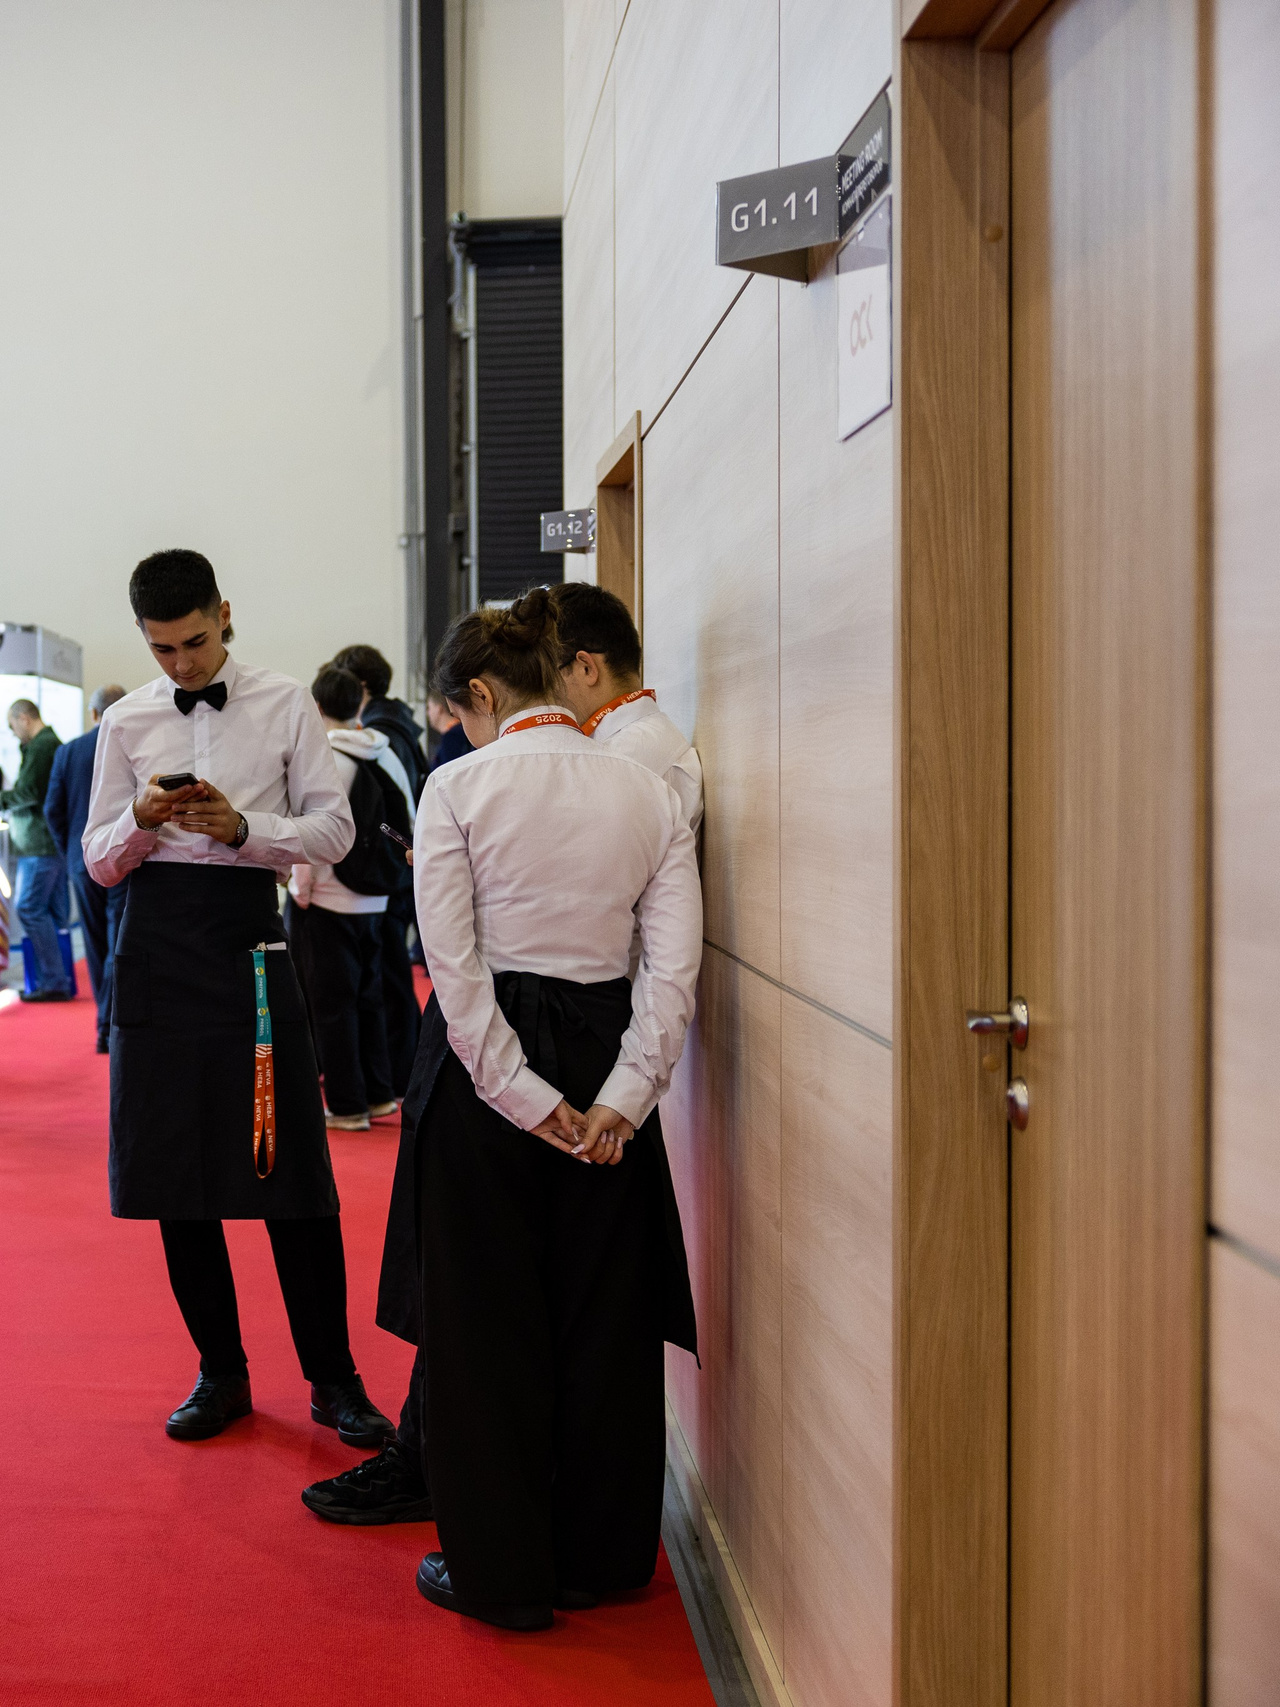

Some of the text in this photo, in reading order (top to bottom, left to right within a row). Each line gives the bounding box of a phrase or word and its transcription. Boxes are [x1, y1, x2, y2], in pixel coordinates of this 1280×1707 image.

[841, 150, 865, 195] MEETING
[865, 126, 883, 164] ROOM
[731, 187, 818, 232] G1.11
[546, 520, 583, 537] G1.12
[535, 714, 563, 724] 2025
